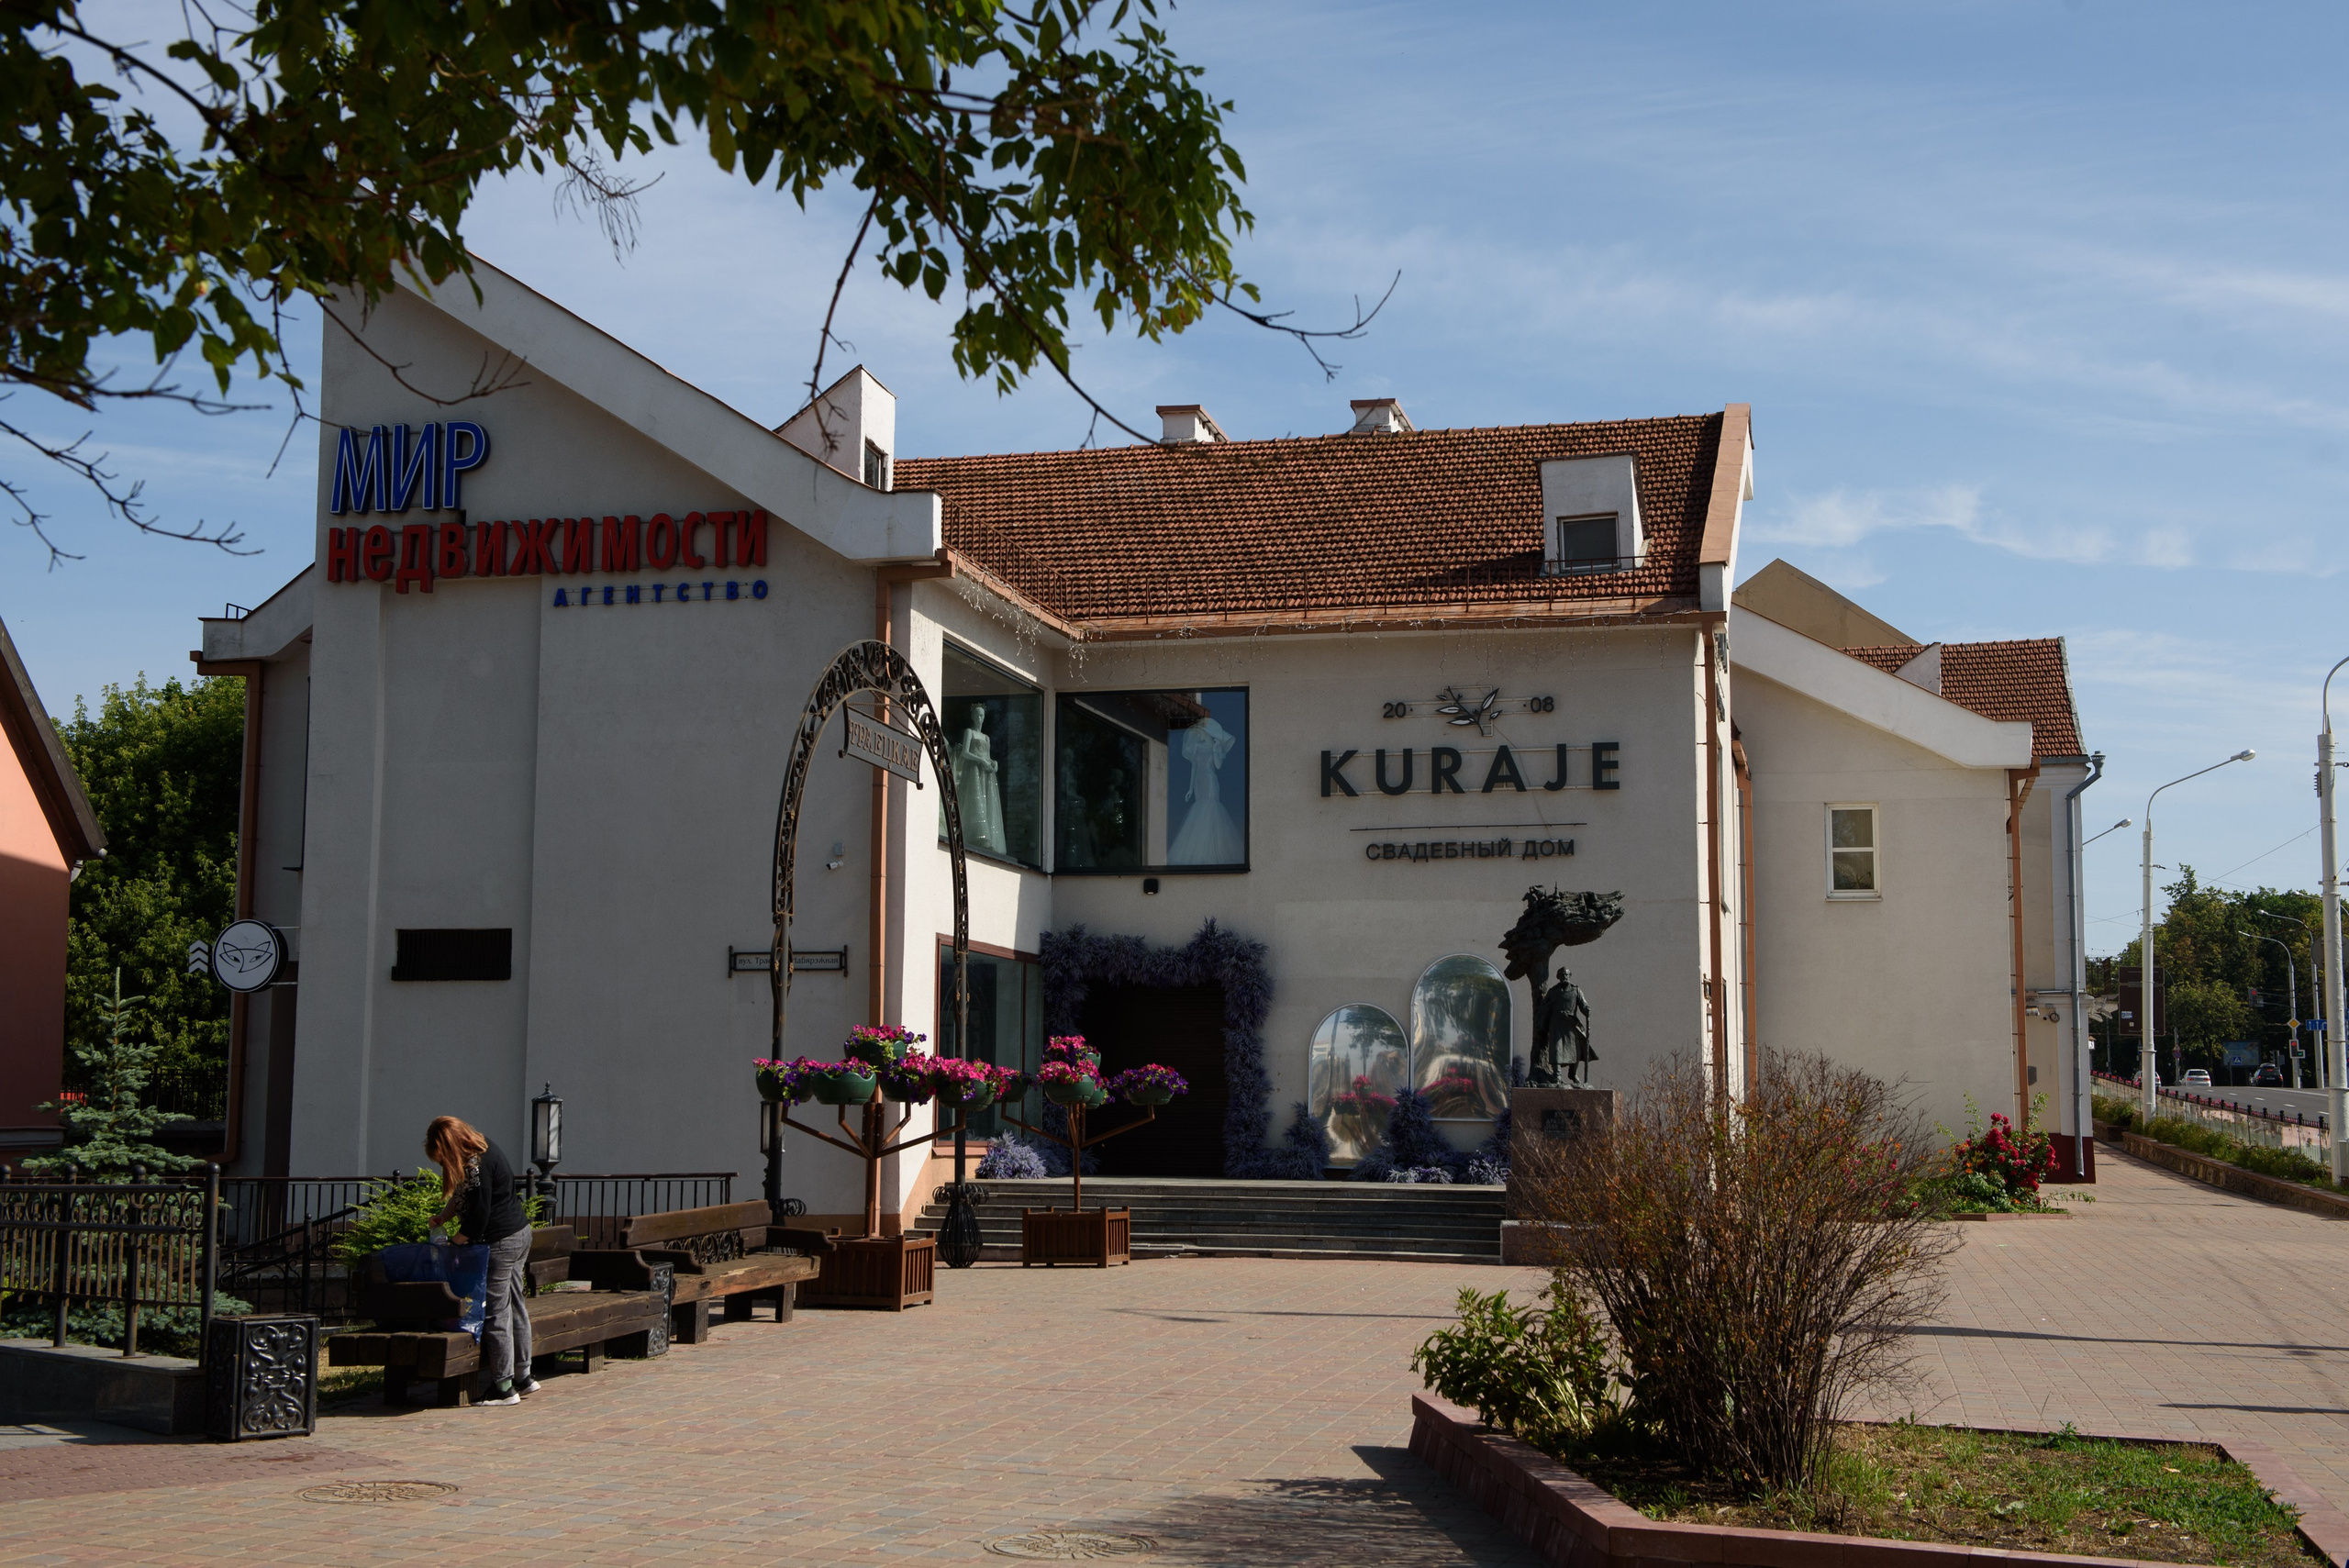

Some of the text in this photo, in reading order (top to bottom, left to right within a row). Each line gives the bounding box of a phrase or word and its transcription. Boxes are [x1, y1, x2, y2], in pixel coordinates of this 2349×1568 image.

[329, 420, 491, 516] МИР
[553, 579, 769, 607] АГЕНТСТВО
[1383, 696, 1554, 718] 20 08
[1320, 741, 1620, 797] KURAJE
[1365, 838, 1575, 862] СВАДЕБНЫЙ ДОМ
